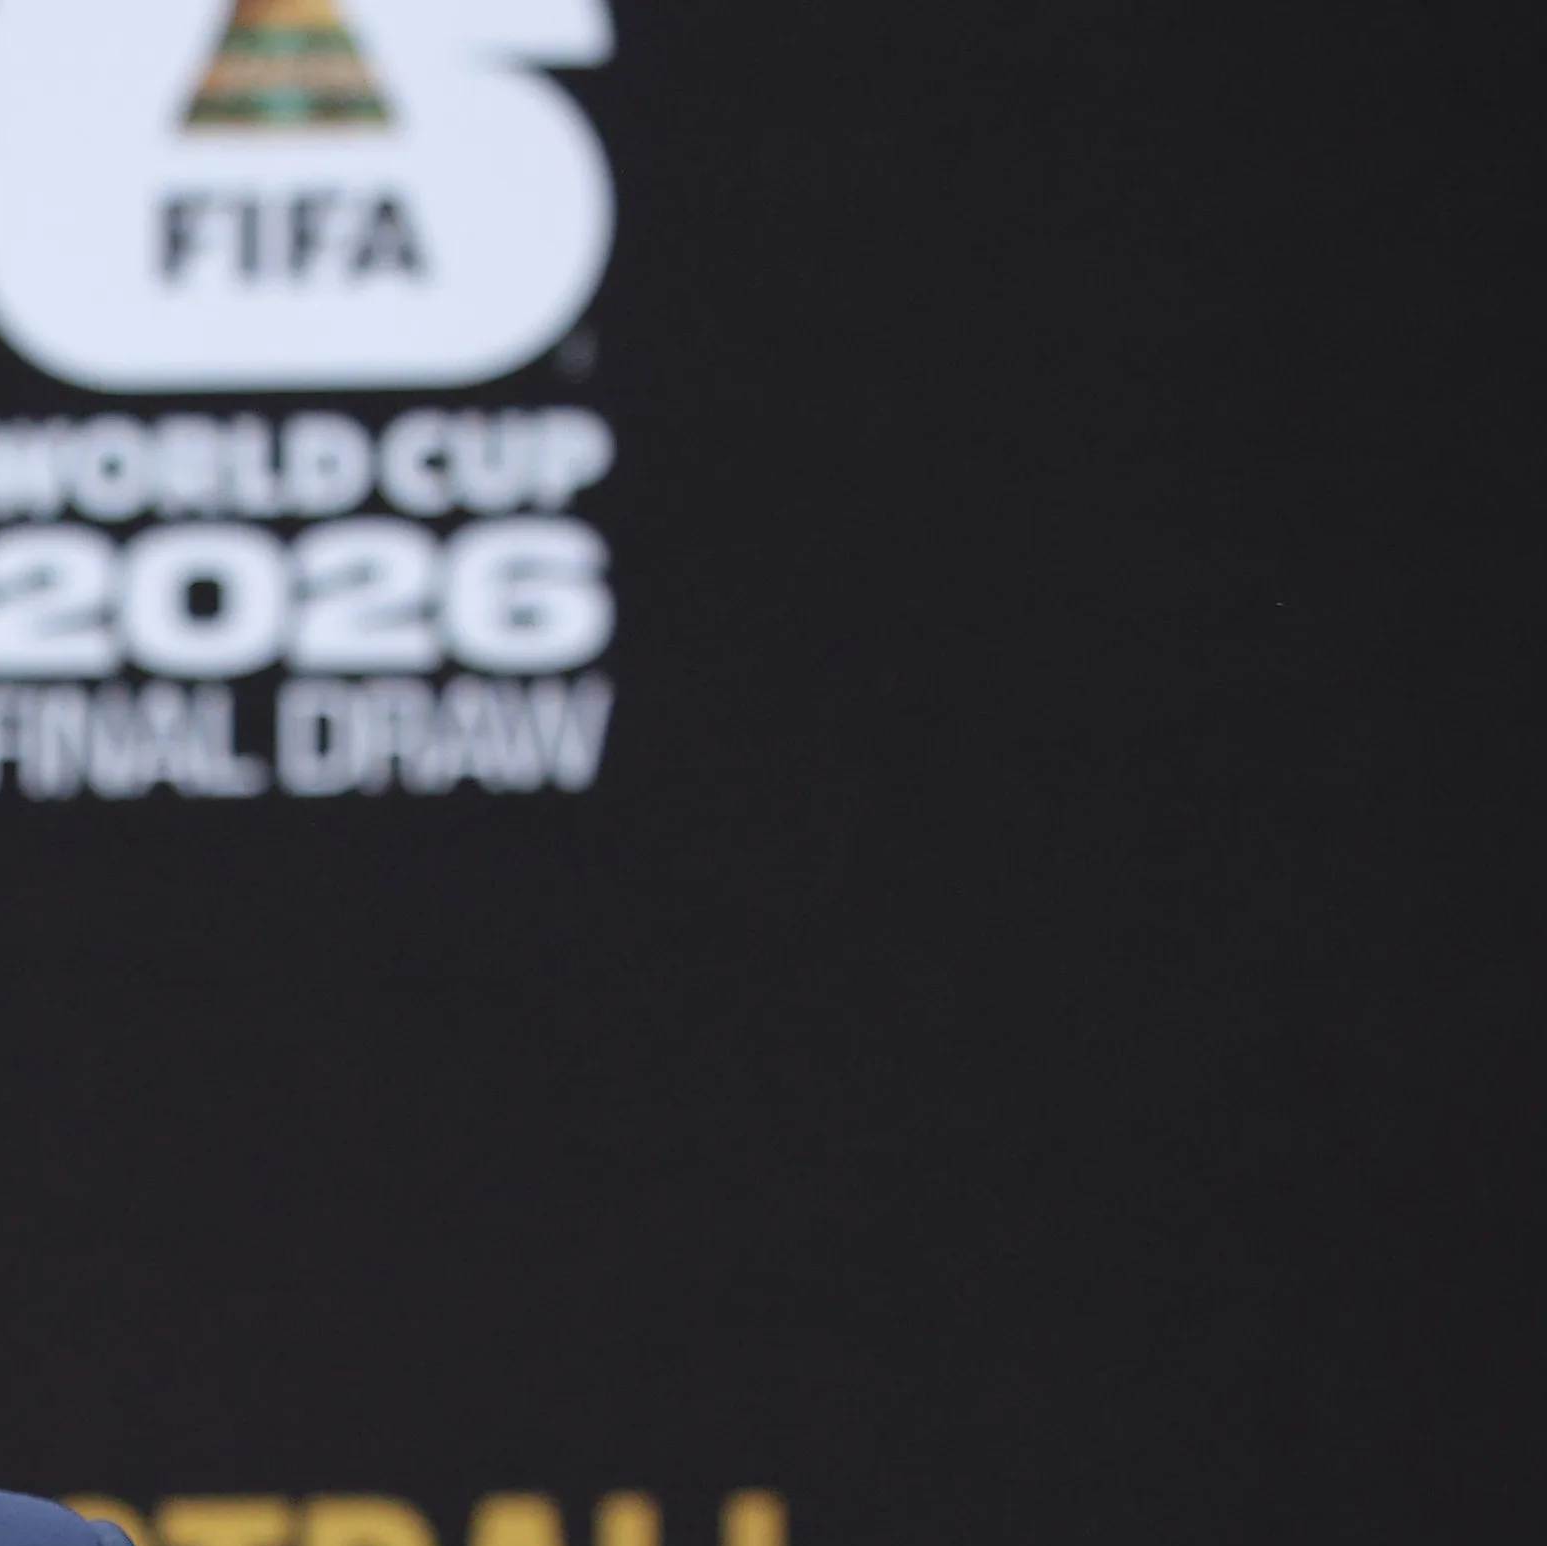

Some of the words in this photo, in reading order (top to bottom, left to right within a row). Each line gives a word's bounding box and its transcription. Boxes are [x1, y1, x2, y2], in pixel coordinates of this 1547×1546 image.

[153, 188, 427, 282] FIFA
[377, 410, 615, 516] CUP
[275, 677, 613, 797] DRAW
